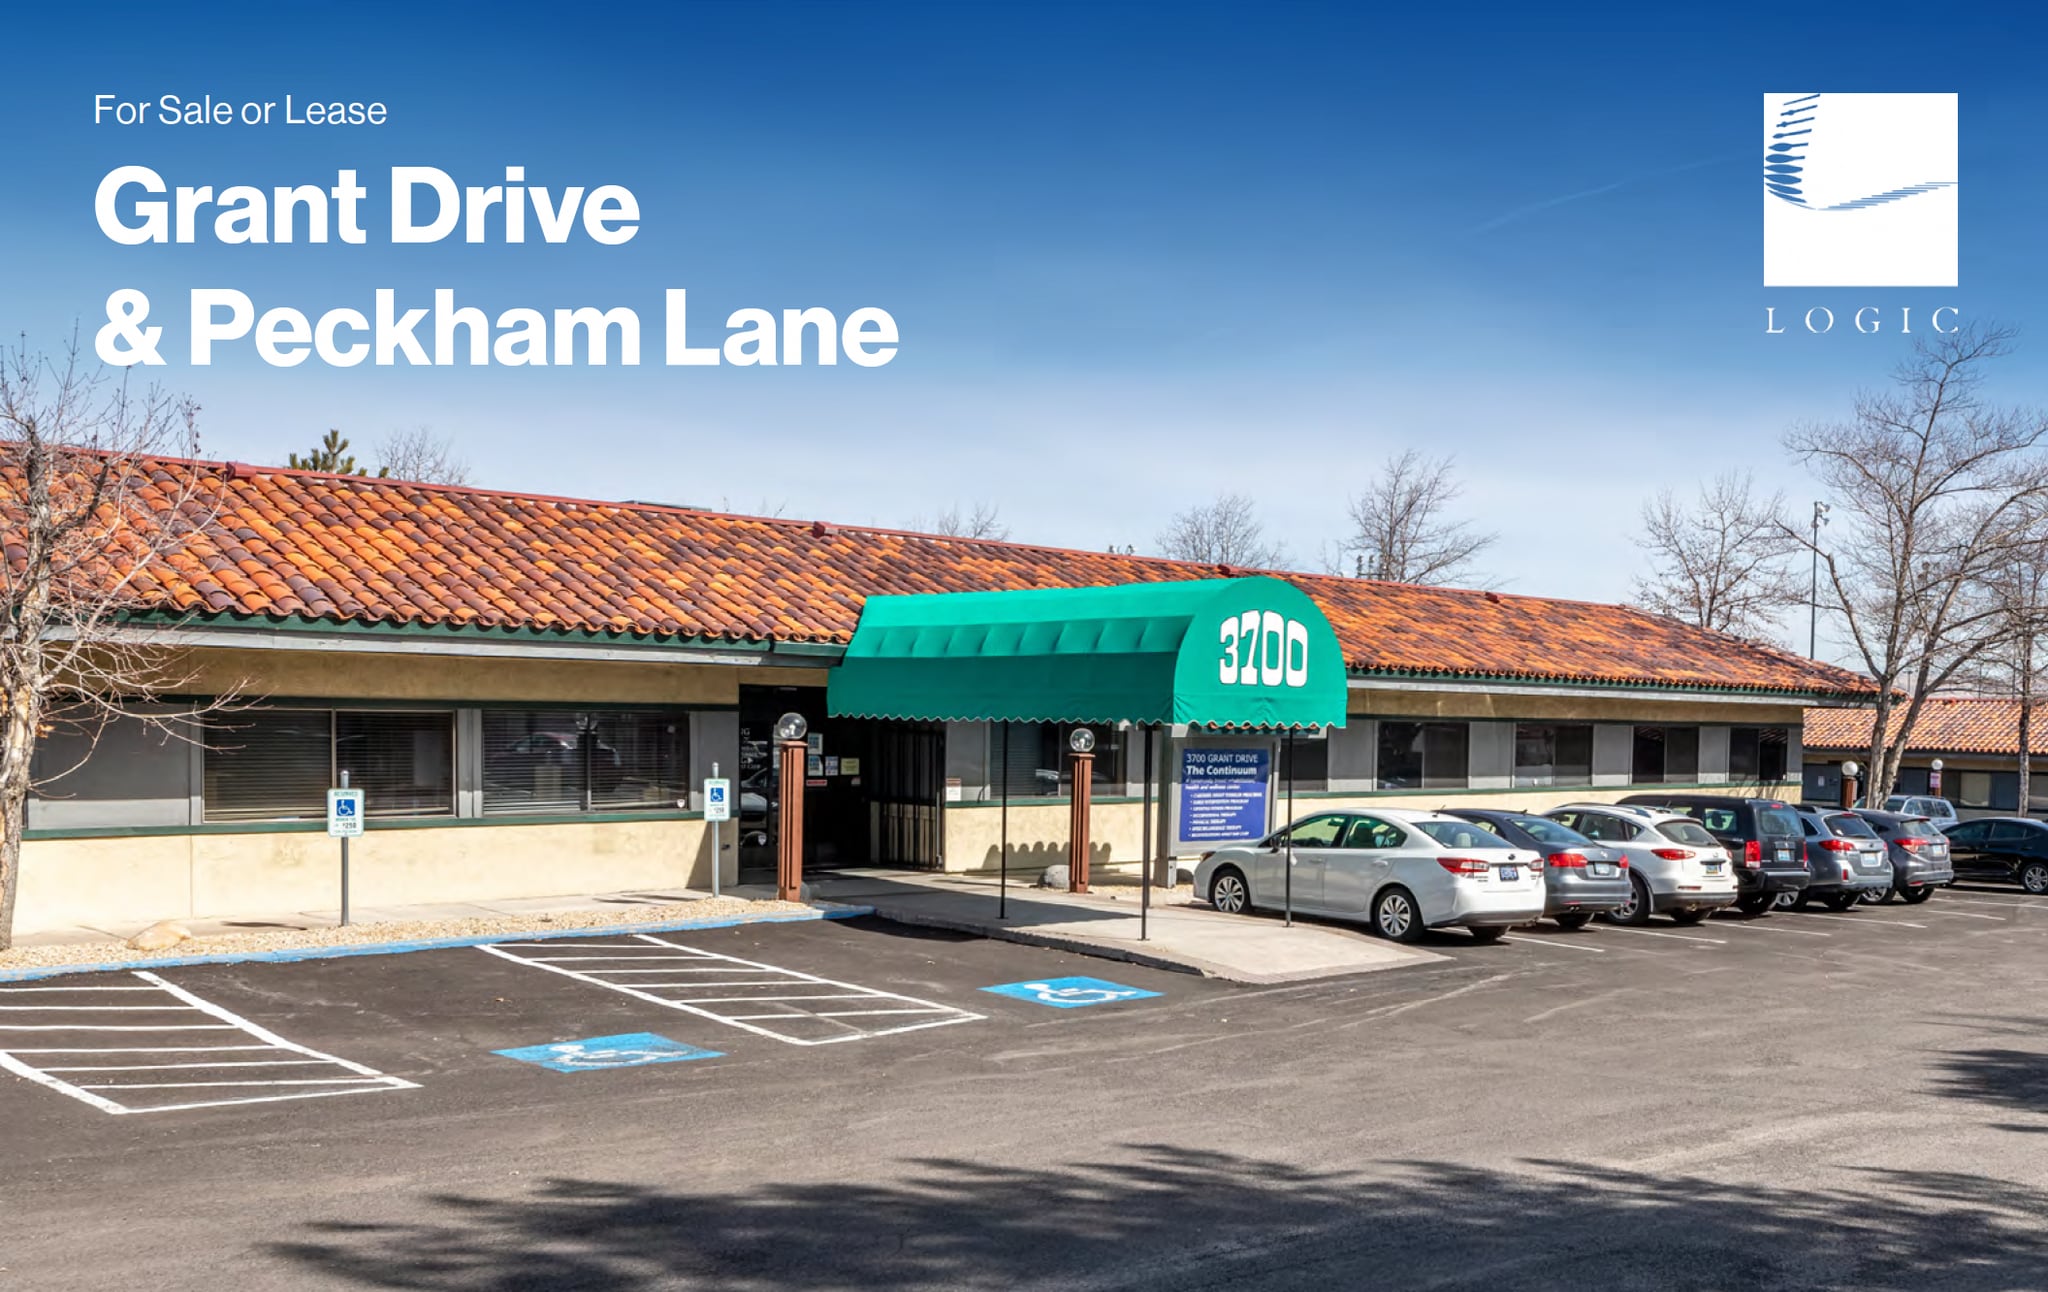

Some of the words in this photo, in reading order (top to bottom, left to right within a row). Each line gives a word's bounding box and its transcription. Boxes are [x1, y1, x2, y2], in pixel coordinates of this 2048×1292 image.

[1219, 609, 1308, 688] 3700
[1186, 753, 1206, 763] 3700
[1207, 753, 1233, 763] GRANT
[1235, 753, 1258, 763] DRIVE
[1186, 765, 1205, 775] The
[1206, 765, 1257, 775] Continuum
